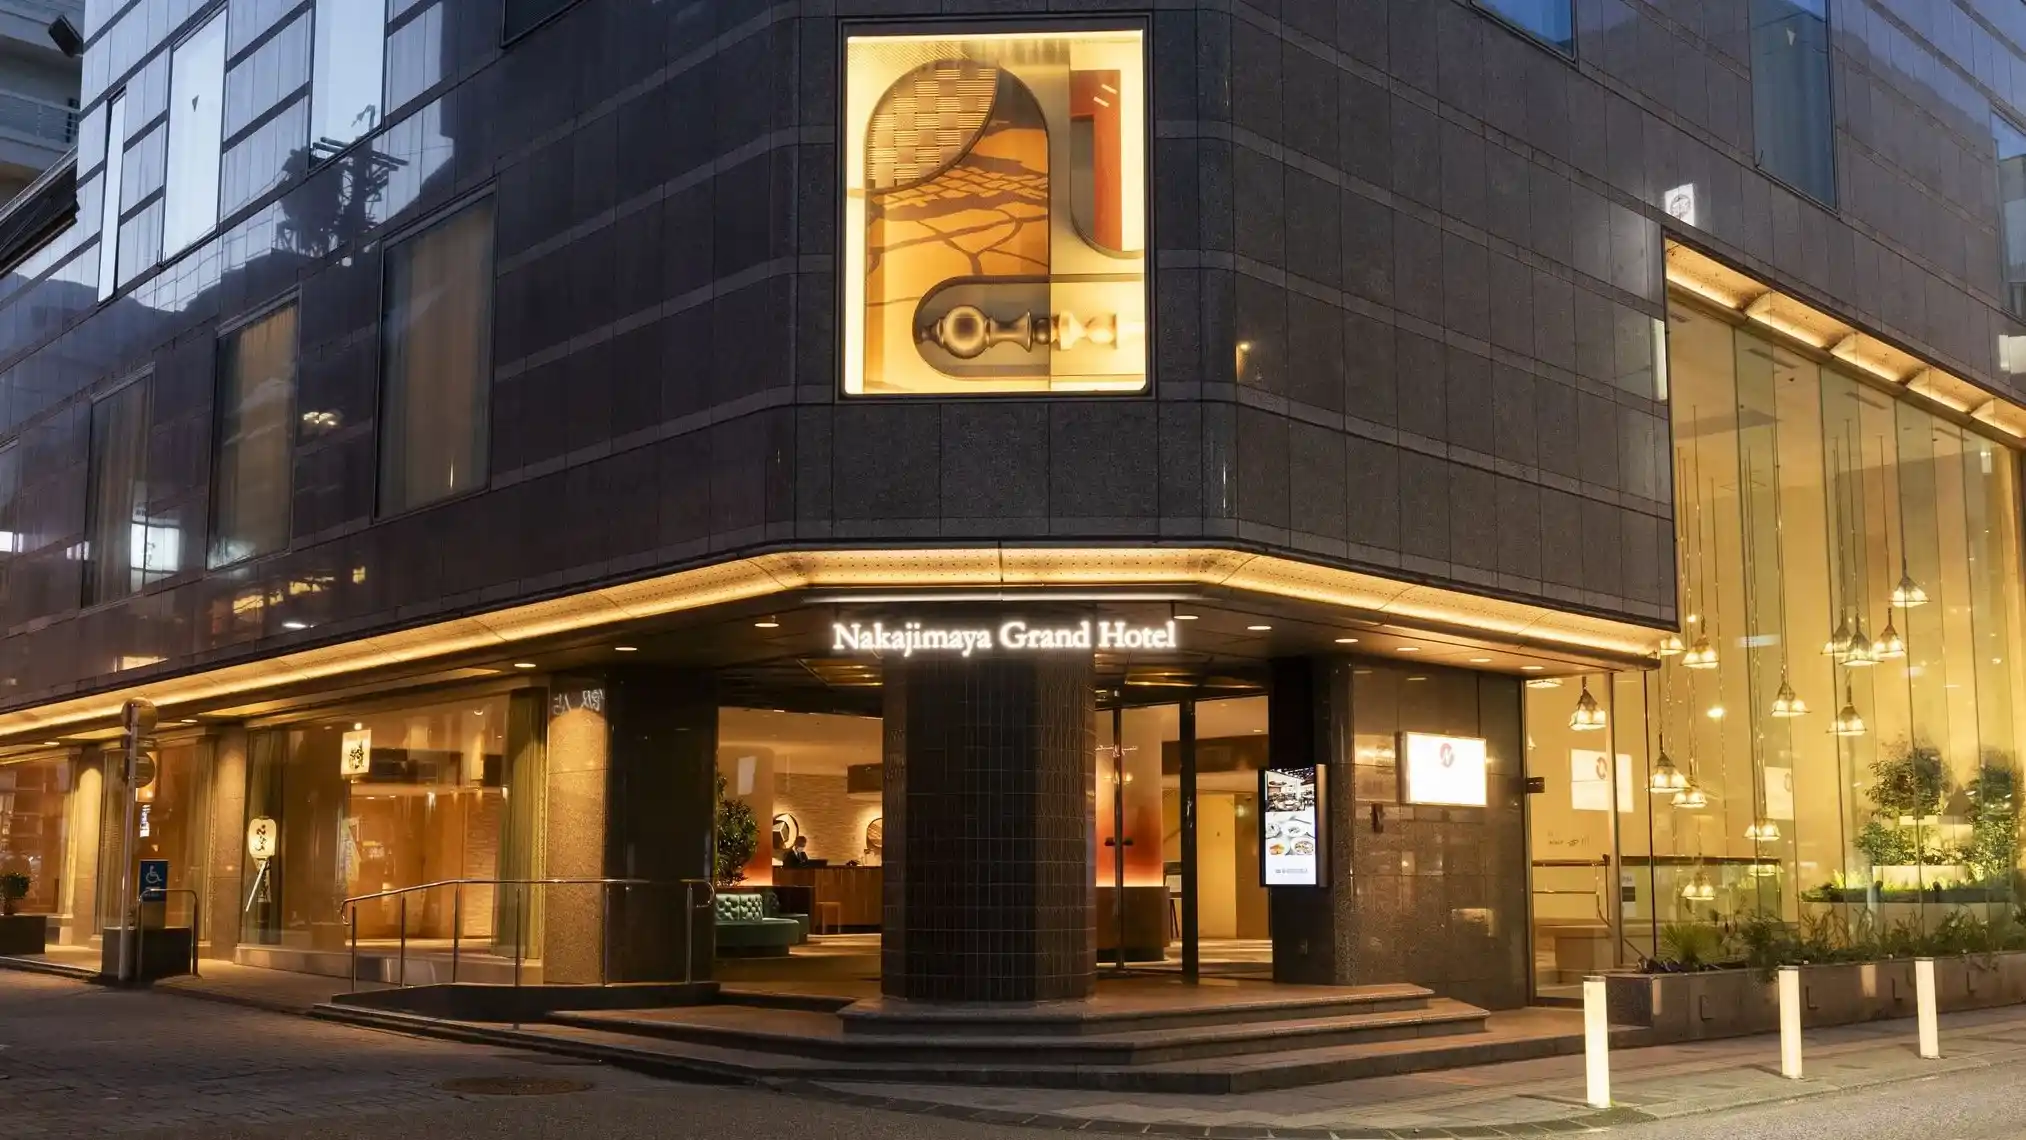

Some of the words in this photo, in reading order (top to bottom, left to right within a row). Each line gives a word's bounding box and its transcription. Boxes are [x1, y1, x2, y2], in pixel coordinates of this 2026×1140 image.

[832, 621, 992, 657] Nakajimaya
[999, 620, 1091, 649] Grand
[1098, 620, 1176, 649] Hotel
